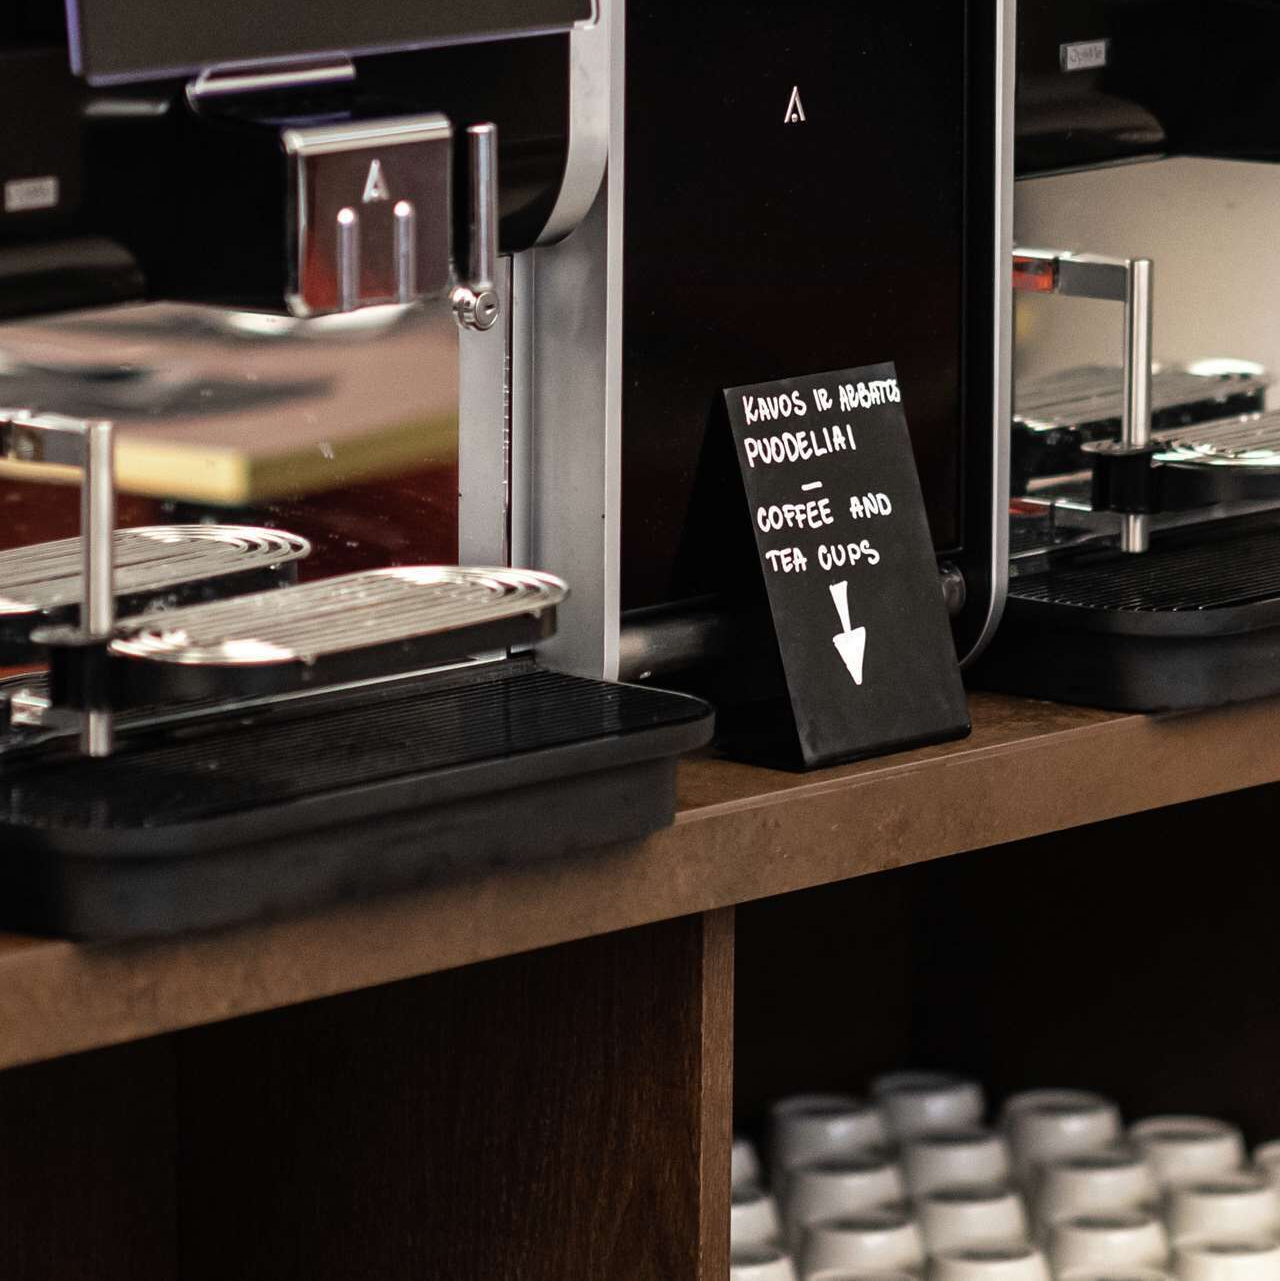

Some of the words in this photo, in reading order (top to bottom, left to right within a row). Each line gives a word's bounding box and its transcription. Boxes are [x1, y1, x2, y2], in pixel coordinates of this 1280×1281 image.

[742, 390, 808, 426] KAVOS
[812, 387, 833, 413] IR
[838, 378, 901, 413] ARBATOS
[743, 423, 857, 468] PUODELIAI
[756, 497, 835, 533] COFFEE
[849, 492, 893, 520] AND
[764, 547, 808, 573] TEA
[817, 539, 881, 571] CUPS
